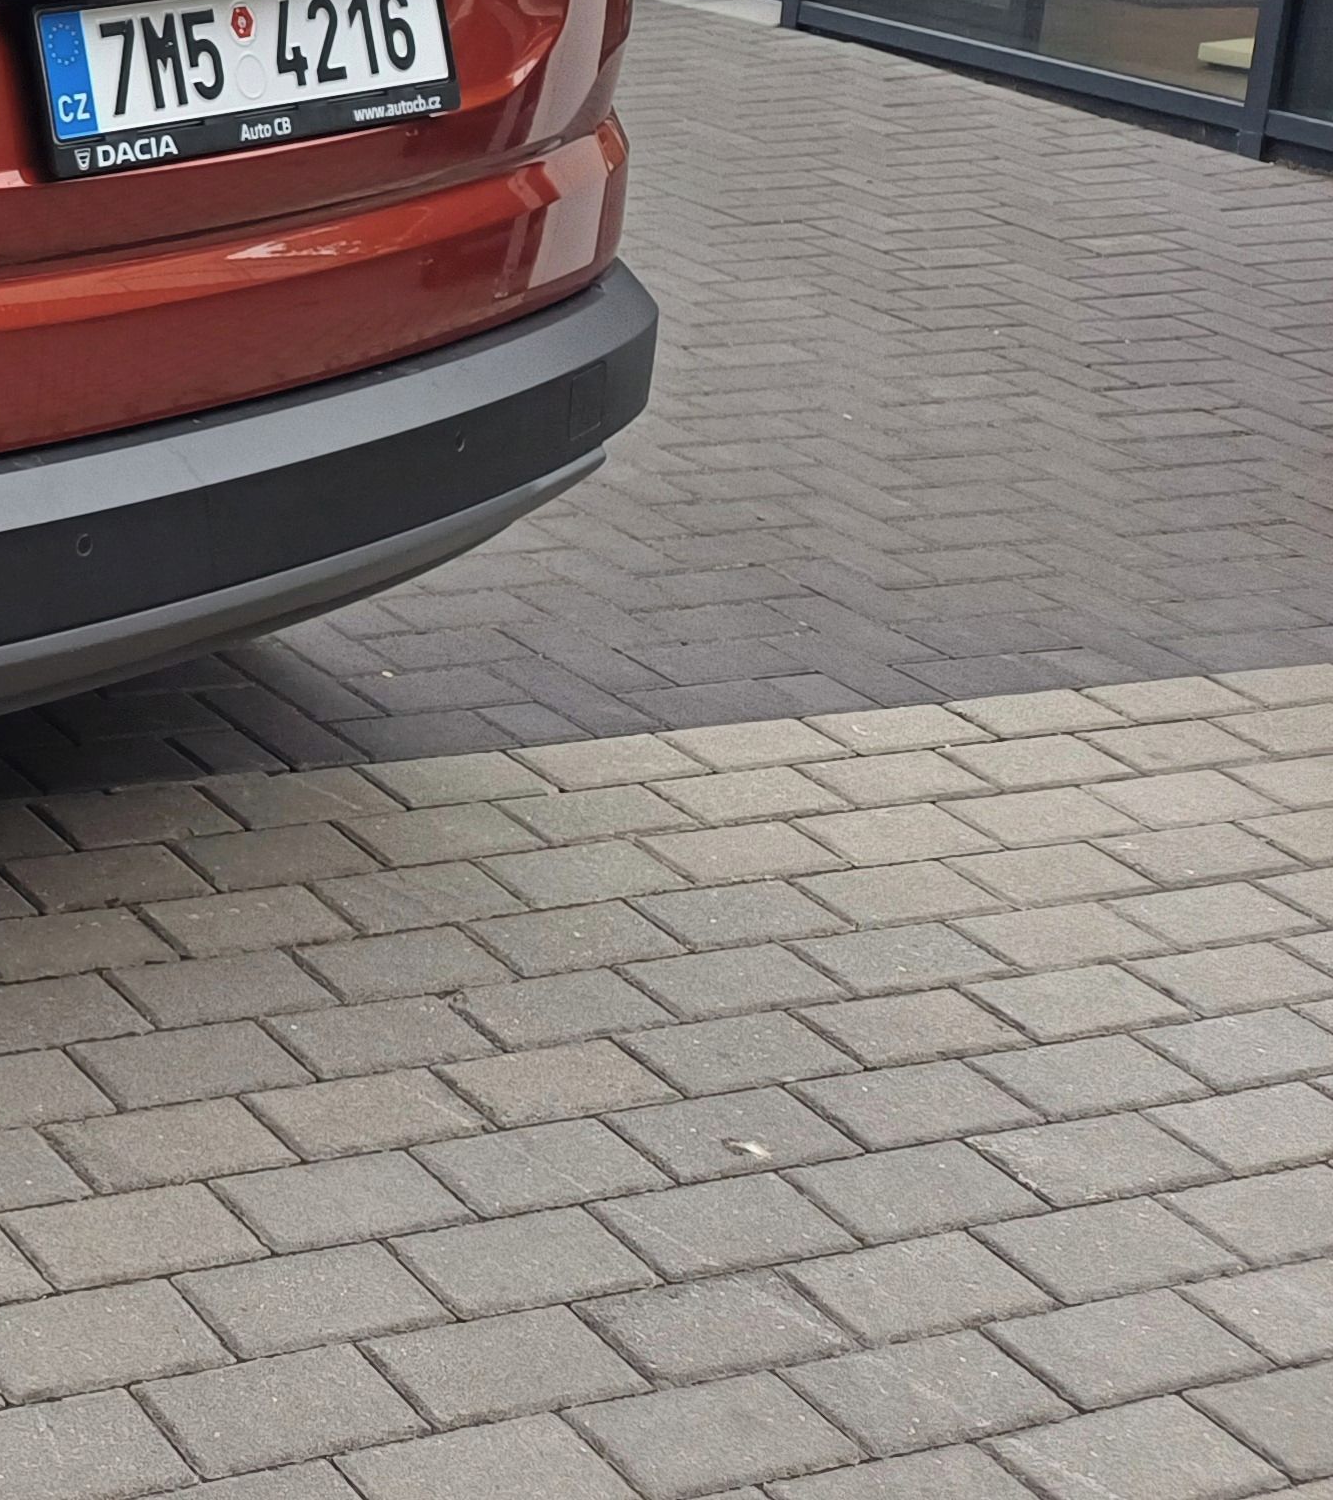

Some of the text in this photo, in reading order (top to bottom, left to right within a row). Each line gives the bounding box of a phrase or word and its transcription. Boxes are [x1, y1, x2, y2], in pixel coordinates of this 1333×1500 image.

[99, 9, 225, 116] 7M5
[58, 93, 91, 123] CZ
[353, 95, 442, 122] www.autocb.cz
[240, 117, 292, 141] Auto CB
[97, 135, 178, 168] DACIA
